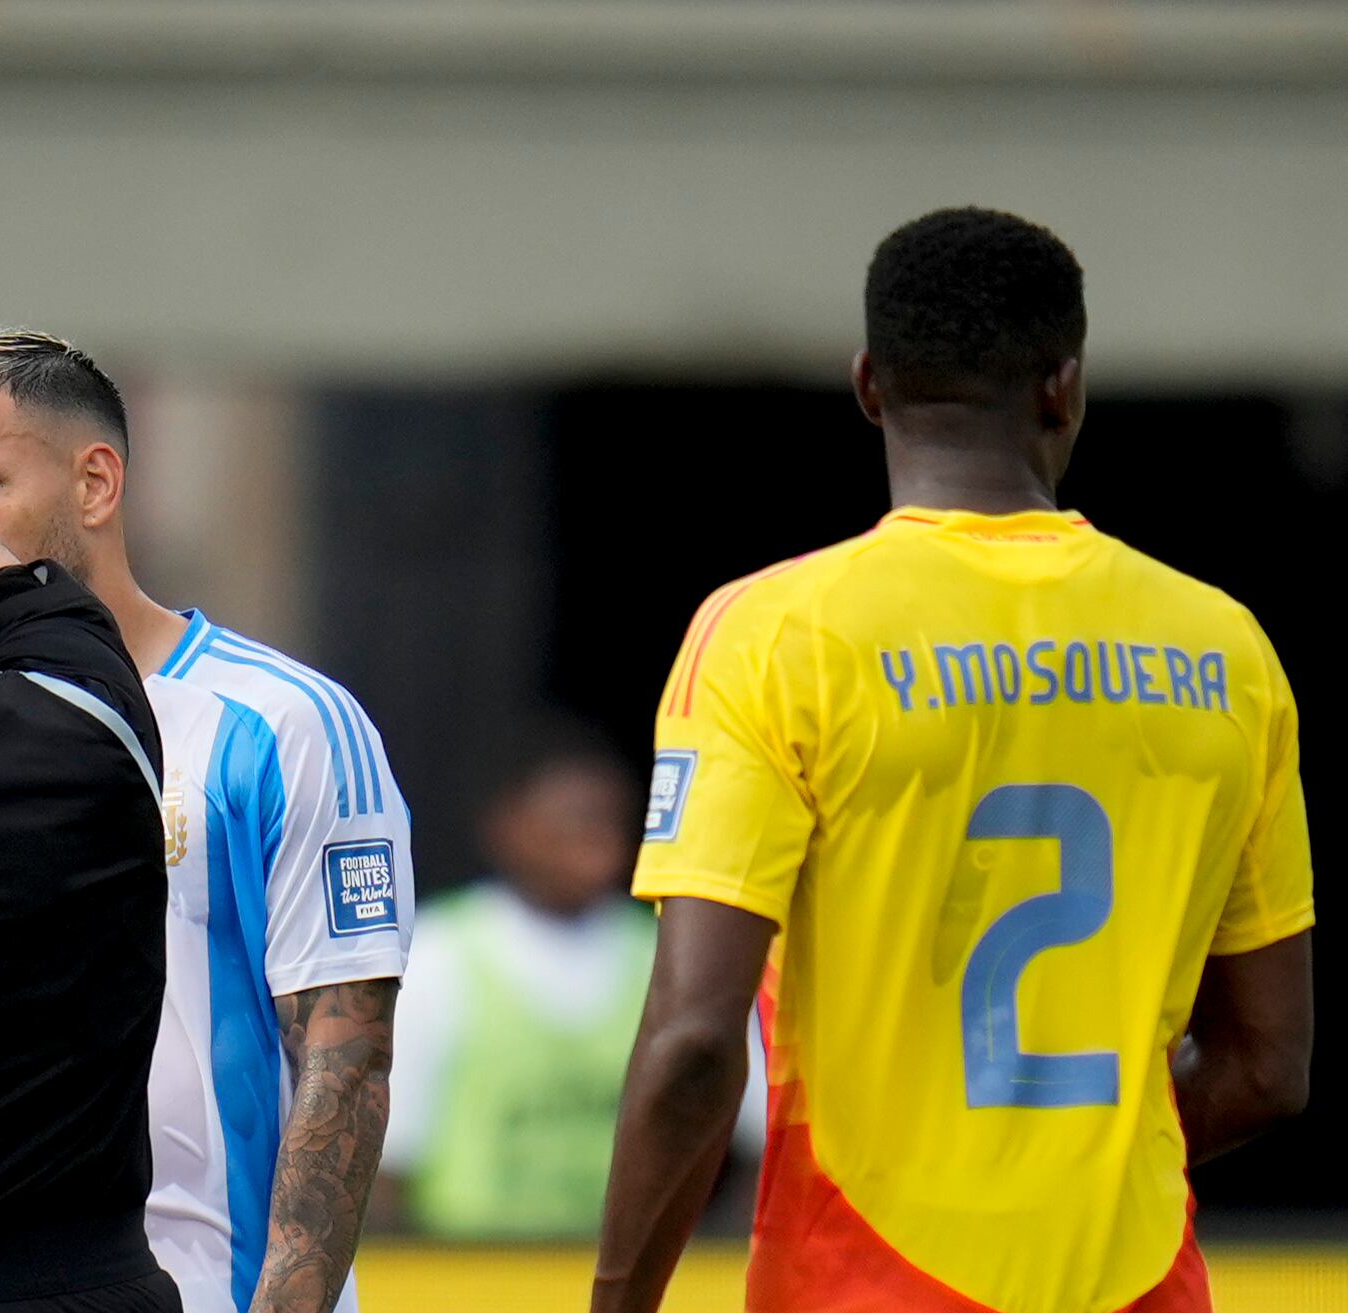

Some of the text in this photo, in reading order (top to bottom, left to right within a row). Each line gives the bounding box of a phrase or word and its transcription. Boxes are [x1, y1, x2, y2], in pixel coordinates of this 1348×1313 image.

[879, 640, 1230, 712] Y.MOSQUERA
[340, 854, 388, 870] FOOTBALL
[342, 867, 390, 888] UNITES
[340, 883, 394, 904] the World
[360, 905, 381, 915] FIFA
[960, 783, 1120, 1109] 2
